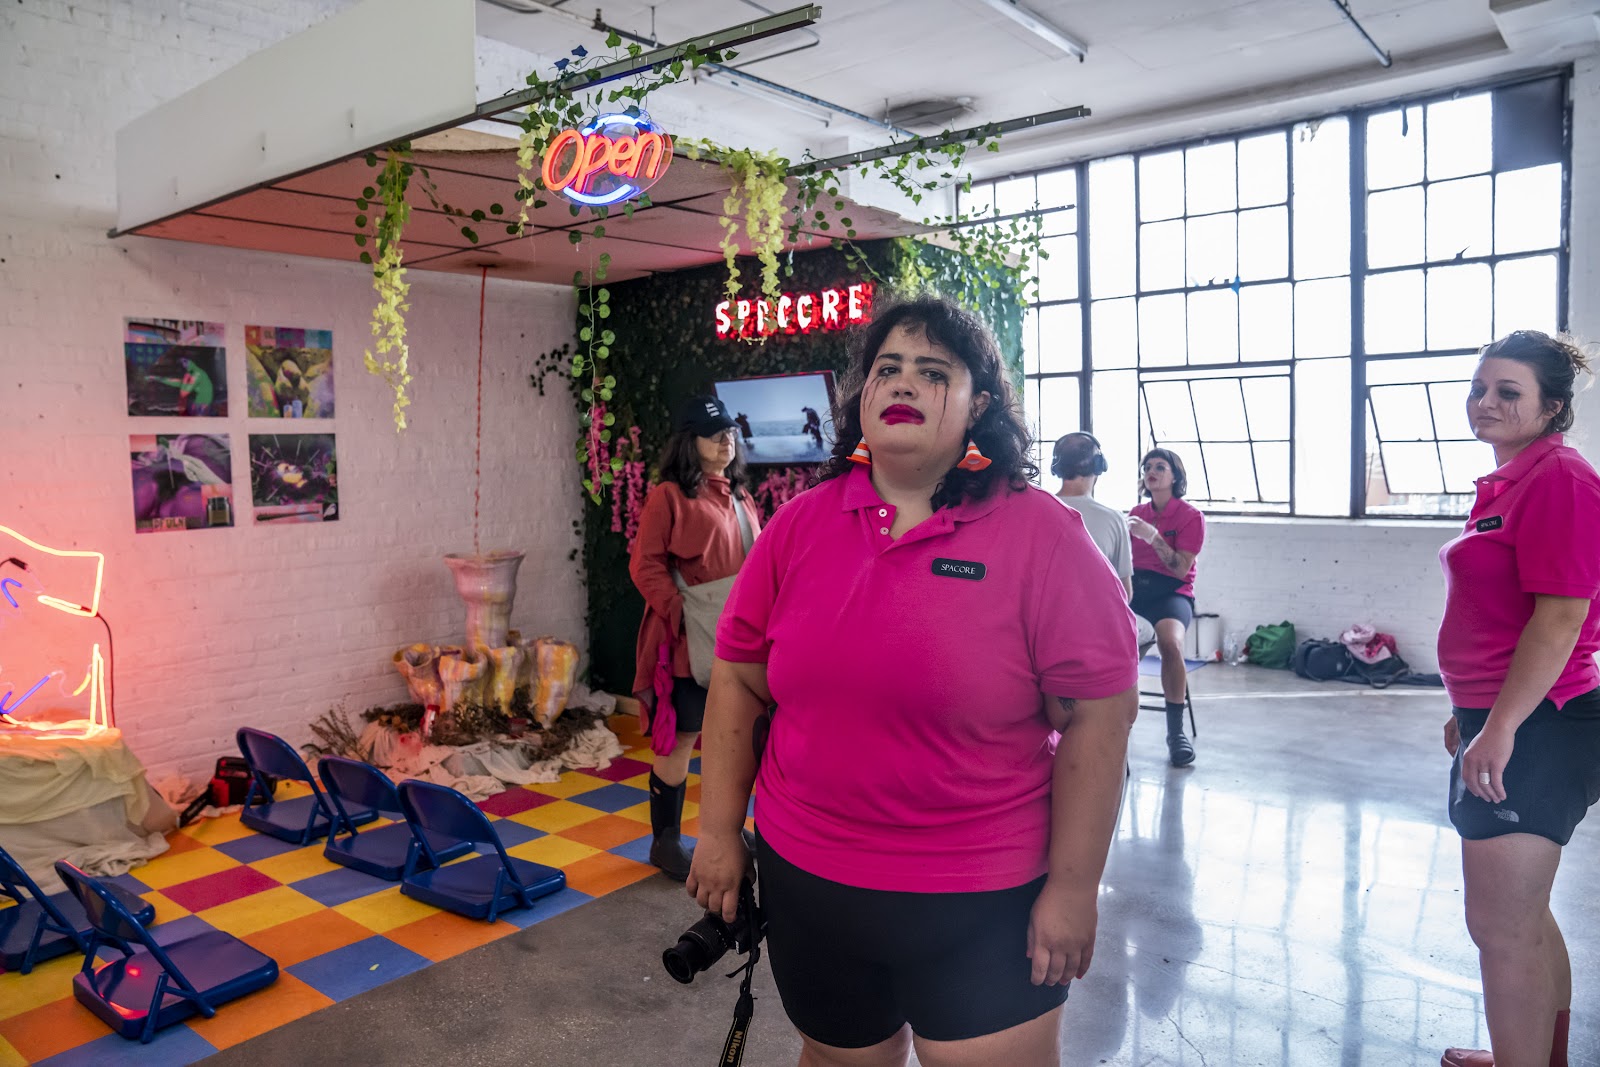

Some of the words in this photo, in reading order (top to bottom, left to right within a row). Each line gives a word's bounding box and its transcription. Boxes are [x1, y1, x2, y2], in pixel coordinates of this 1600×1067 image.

[542, 129, 664, 194] Open
[940, 563, 976, 574] SPACORE
[727, 1030, 743, 1062] Nikon
